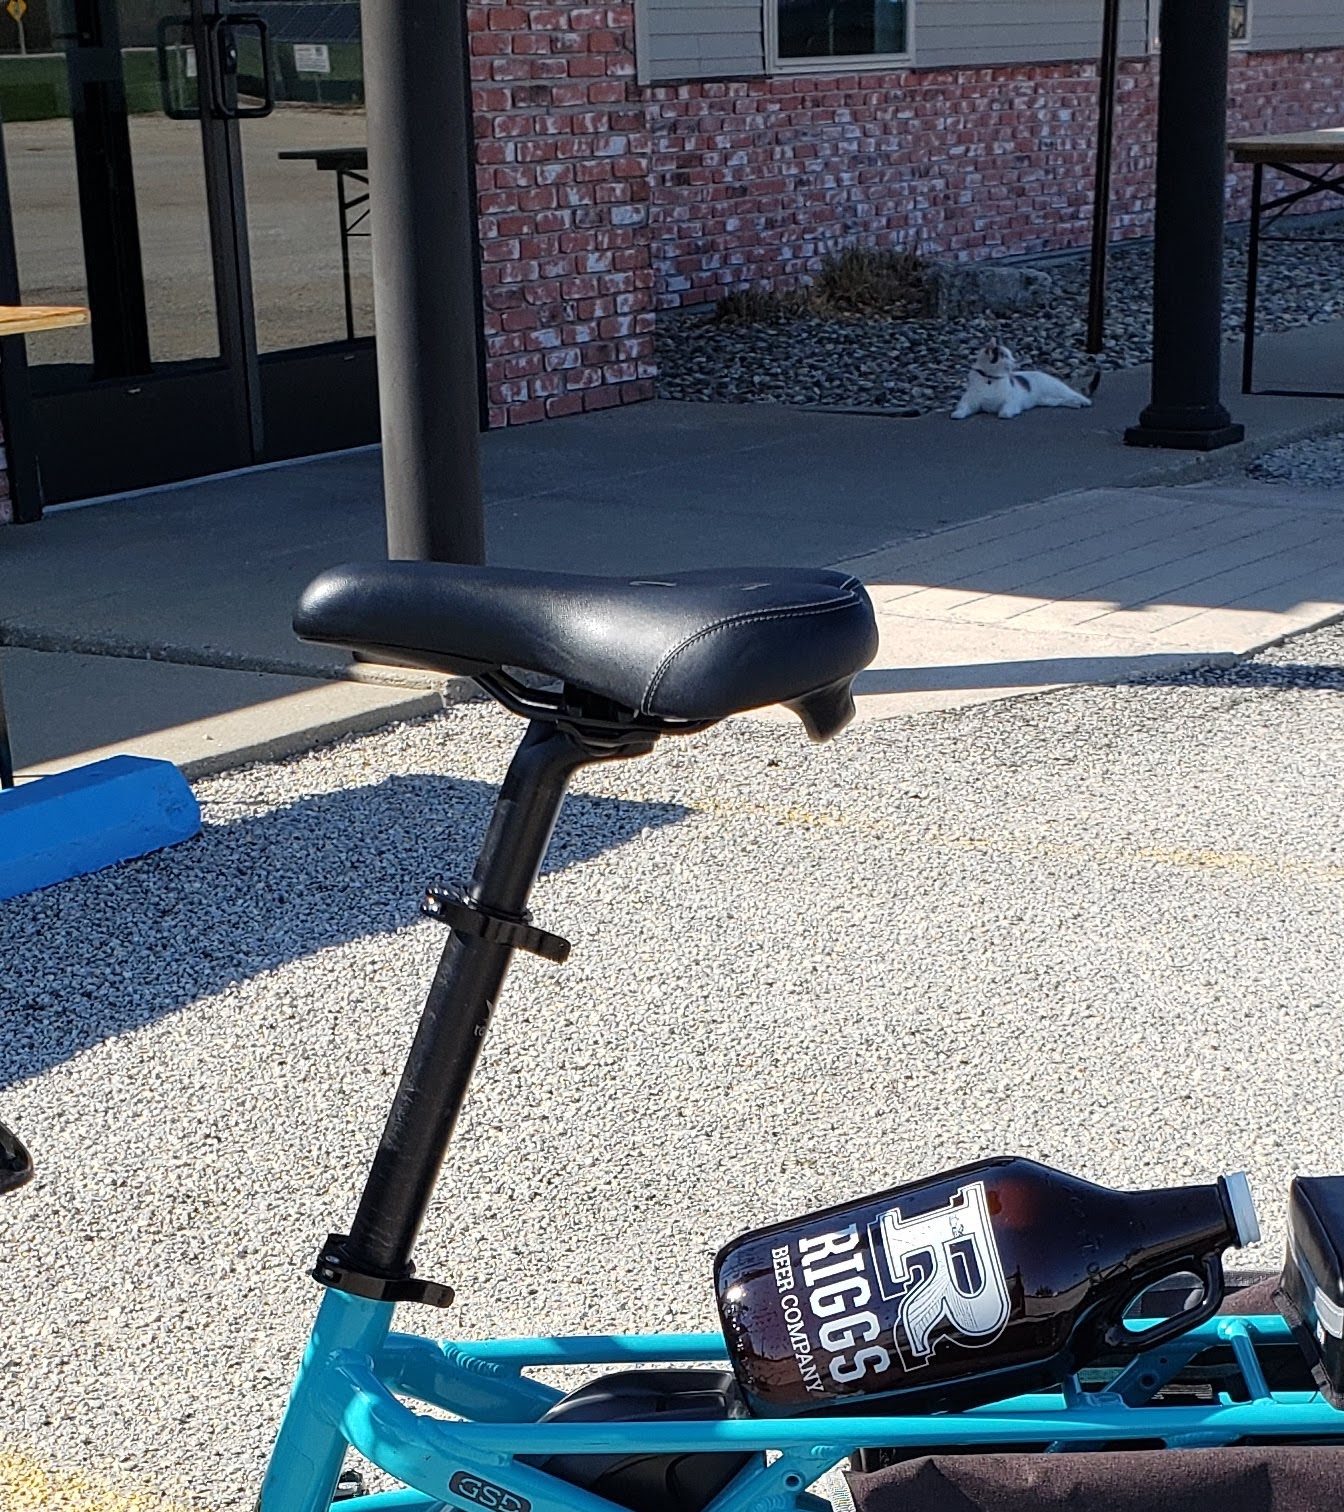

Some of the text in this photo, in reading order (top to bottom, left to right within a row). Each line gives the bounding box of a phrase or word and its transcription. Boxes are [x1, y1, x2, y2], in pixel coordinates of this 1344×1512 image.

[770, 1245, 825, 1395] BEER COMPANY
[797, 1222, 891, 1386] RIGGS
[866, 1180, 1012, 1372] R
